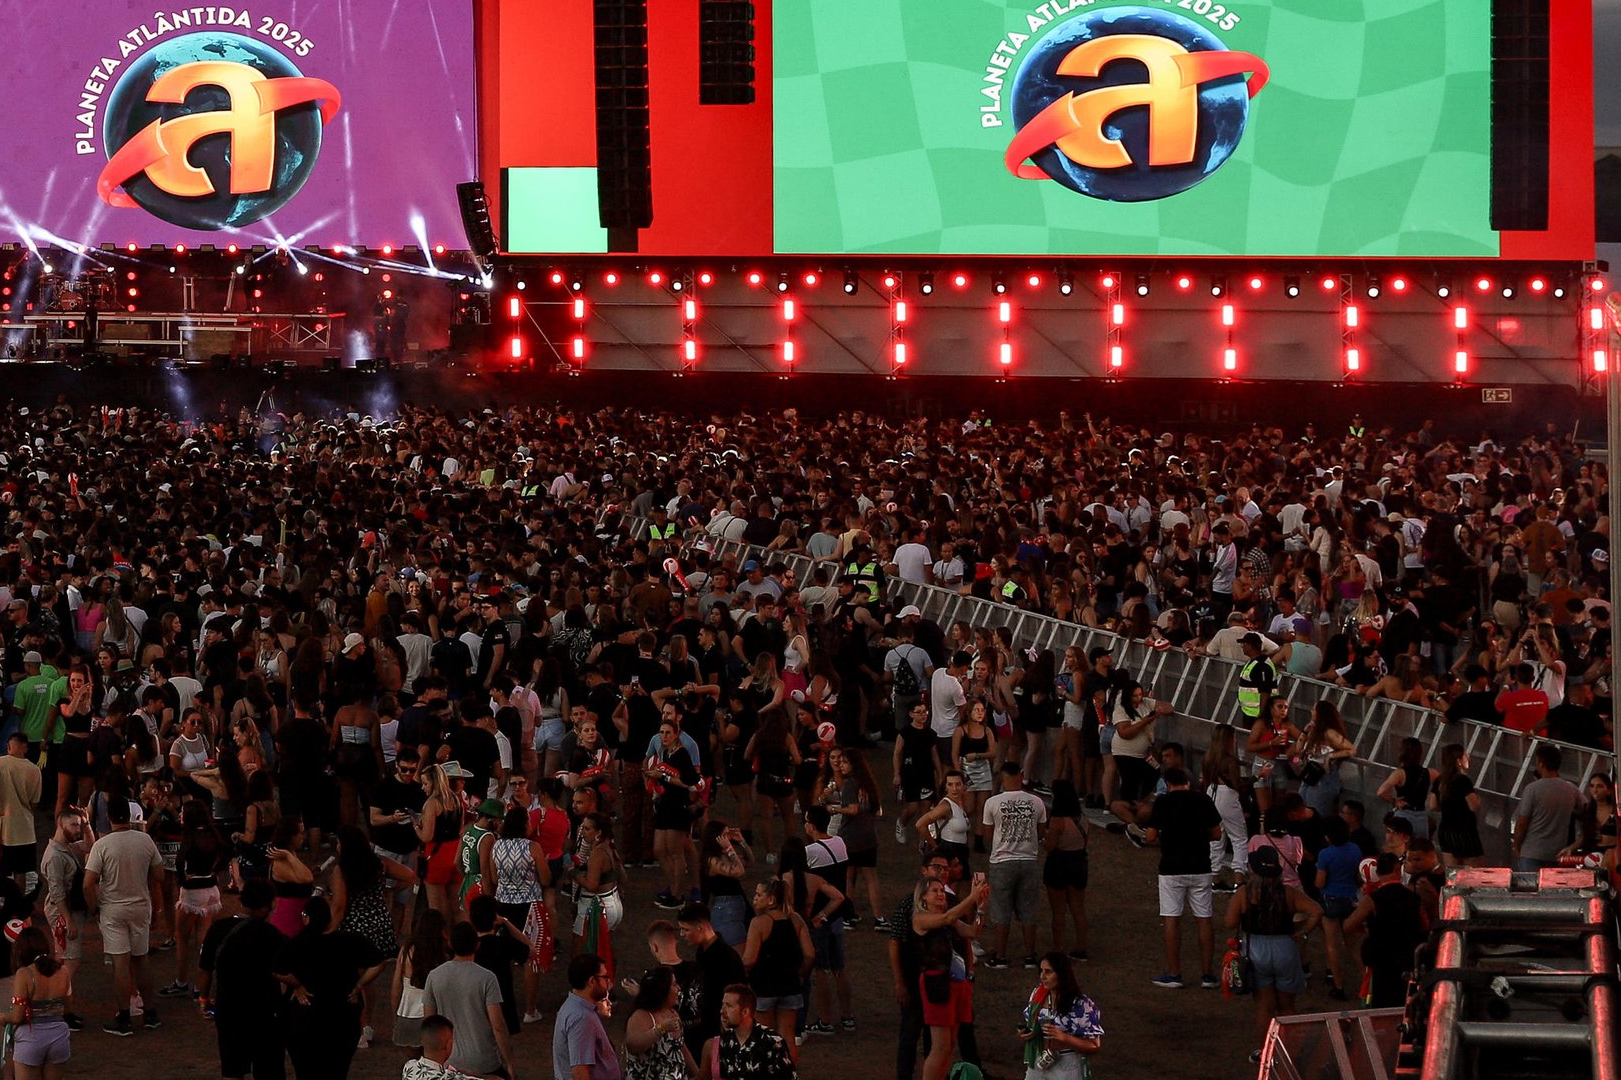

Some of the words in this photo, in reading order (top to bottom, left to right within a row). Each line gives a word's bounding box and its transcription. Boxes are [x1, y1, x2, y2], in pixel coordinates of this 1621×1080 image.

[75, 56, 121, 155] PLANETA
[118, 7, 252, 59] ATLÂNTIDA
[257, 16, 315, 57] 2025
[144, 60, 276, 198] a
[980, 32, 1030, 128] PLANETA
[1056, 34, 1199, 169] a
